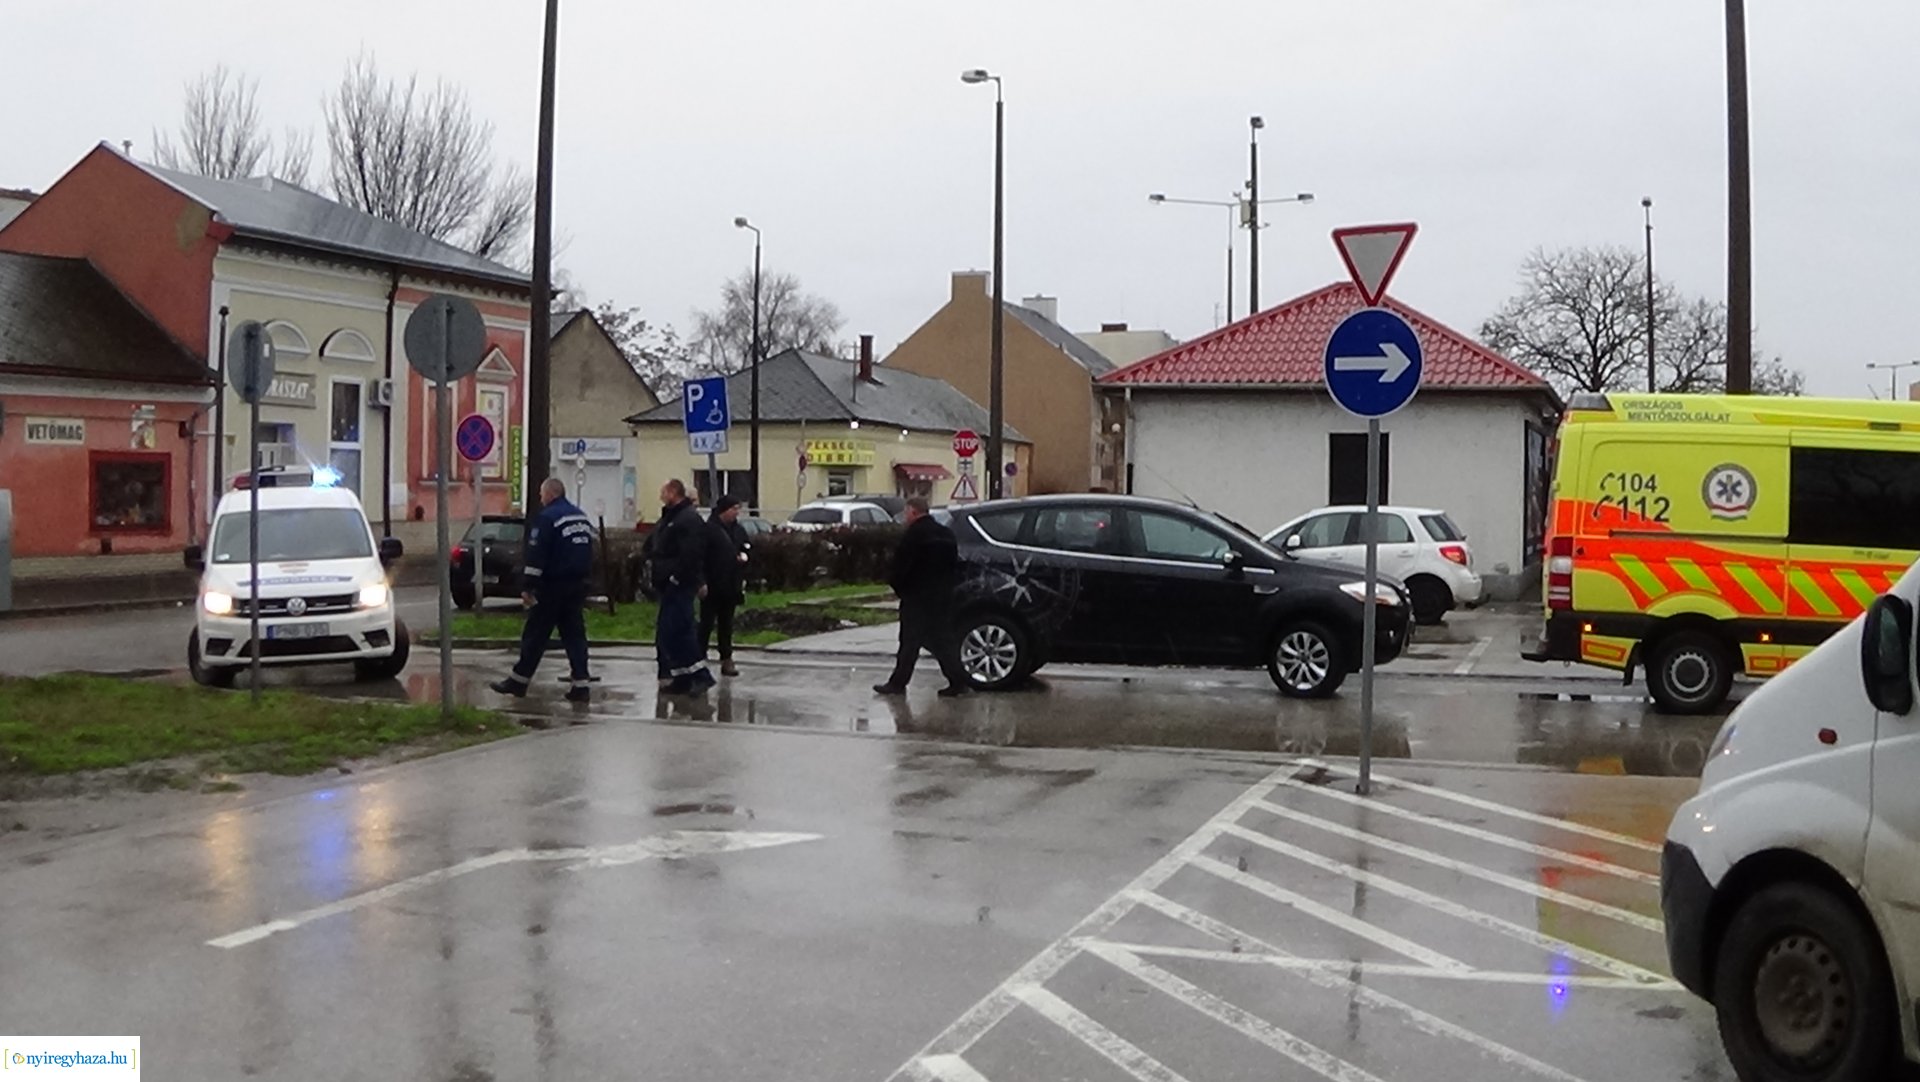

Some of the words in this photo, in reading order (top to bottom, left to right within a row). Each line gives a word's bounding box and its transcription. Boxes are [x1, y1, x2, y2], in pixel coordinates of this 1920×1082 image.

[687, 384, 704, 413] P
[1622, 399, 1684, 410] ORSZÁGOS
[1627, 409, 1731, 422] MENTŐSZOLGÁLAT
[27, 420, 83, 440] VETŐMAG
[953, 438, 979, 449] STOP
[1617, 473, 1657, 493] 104
[1616, 495, 1670, 523] 112
